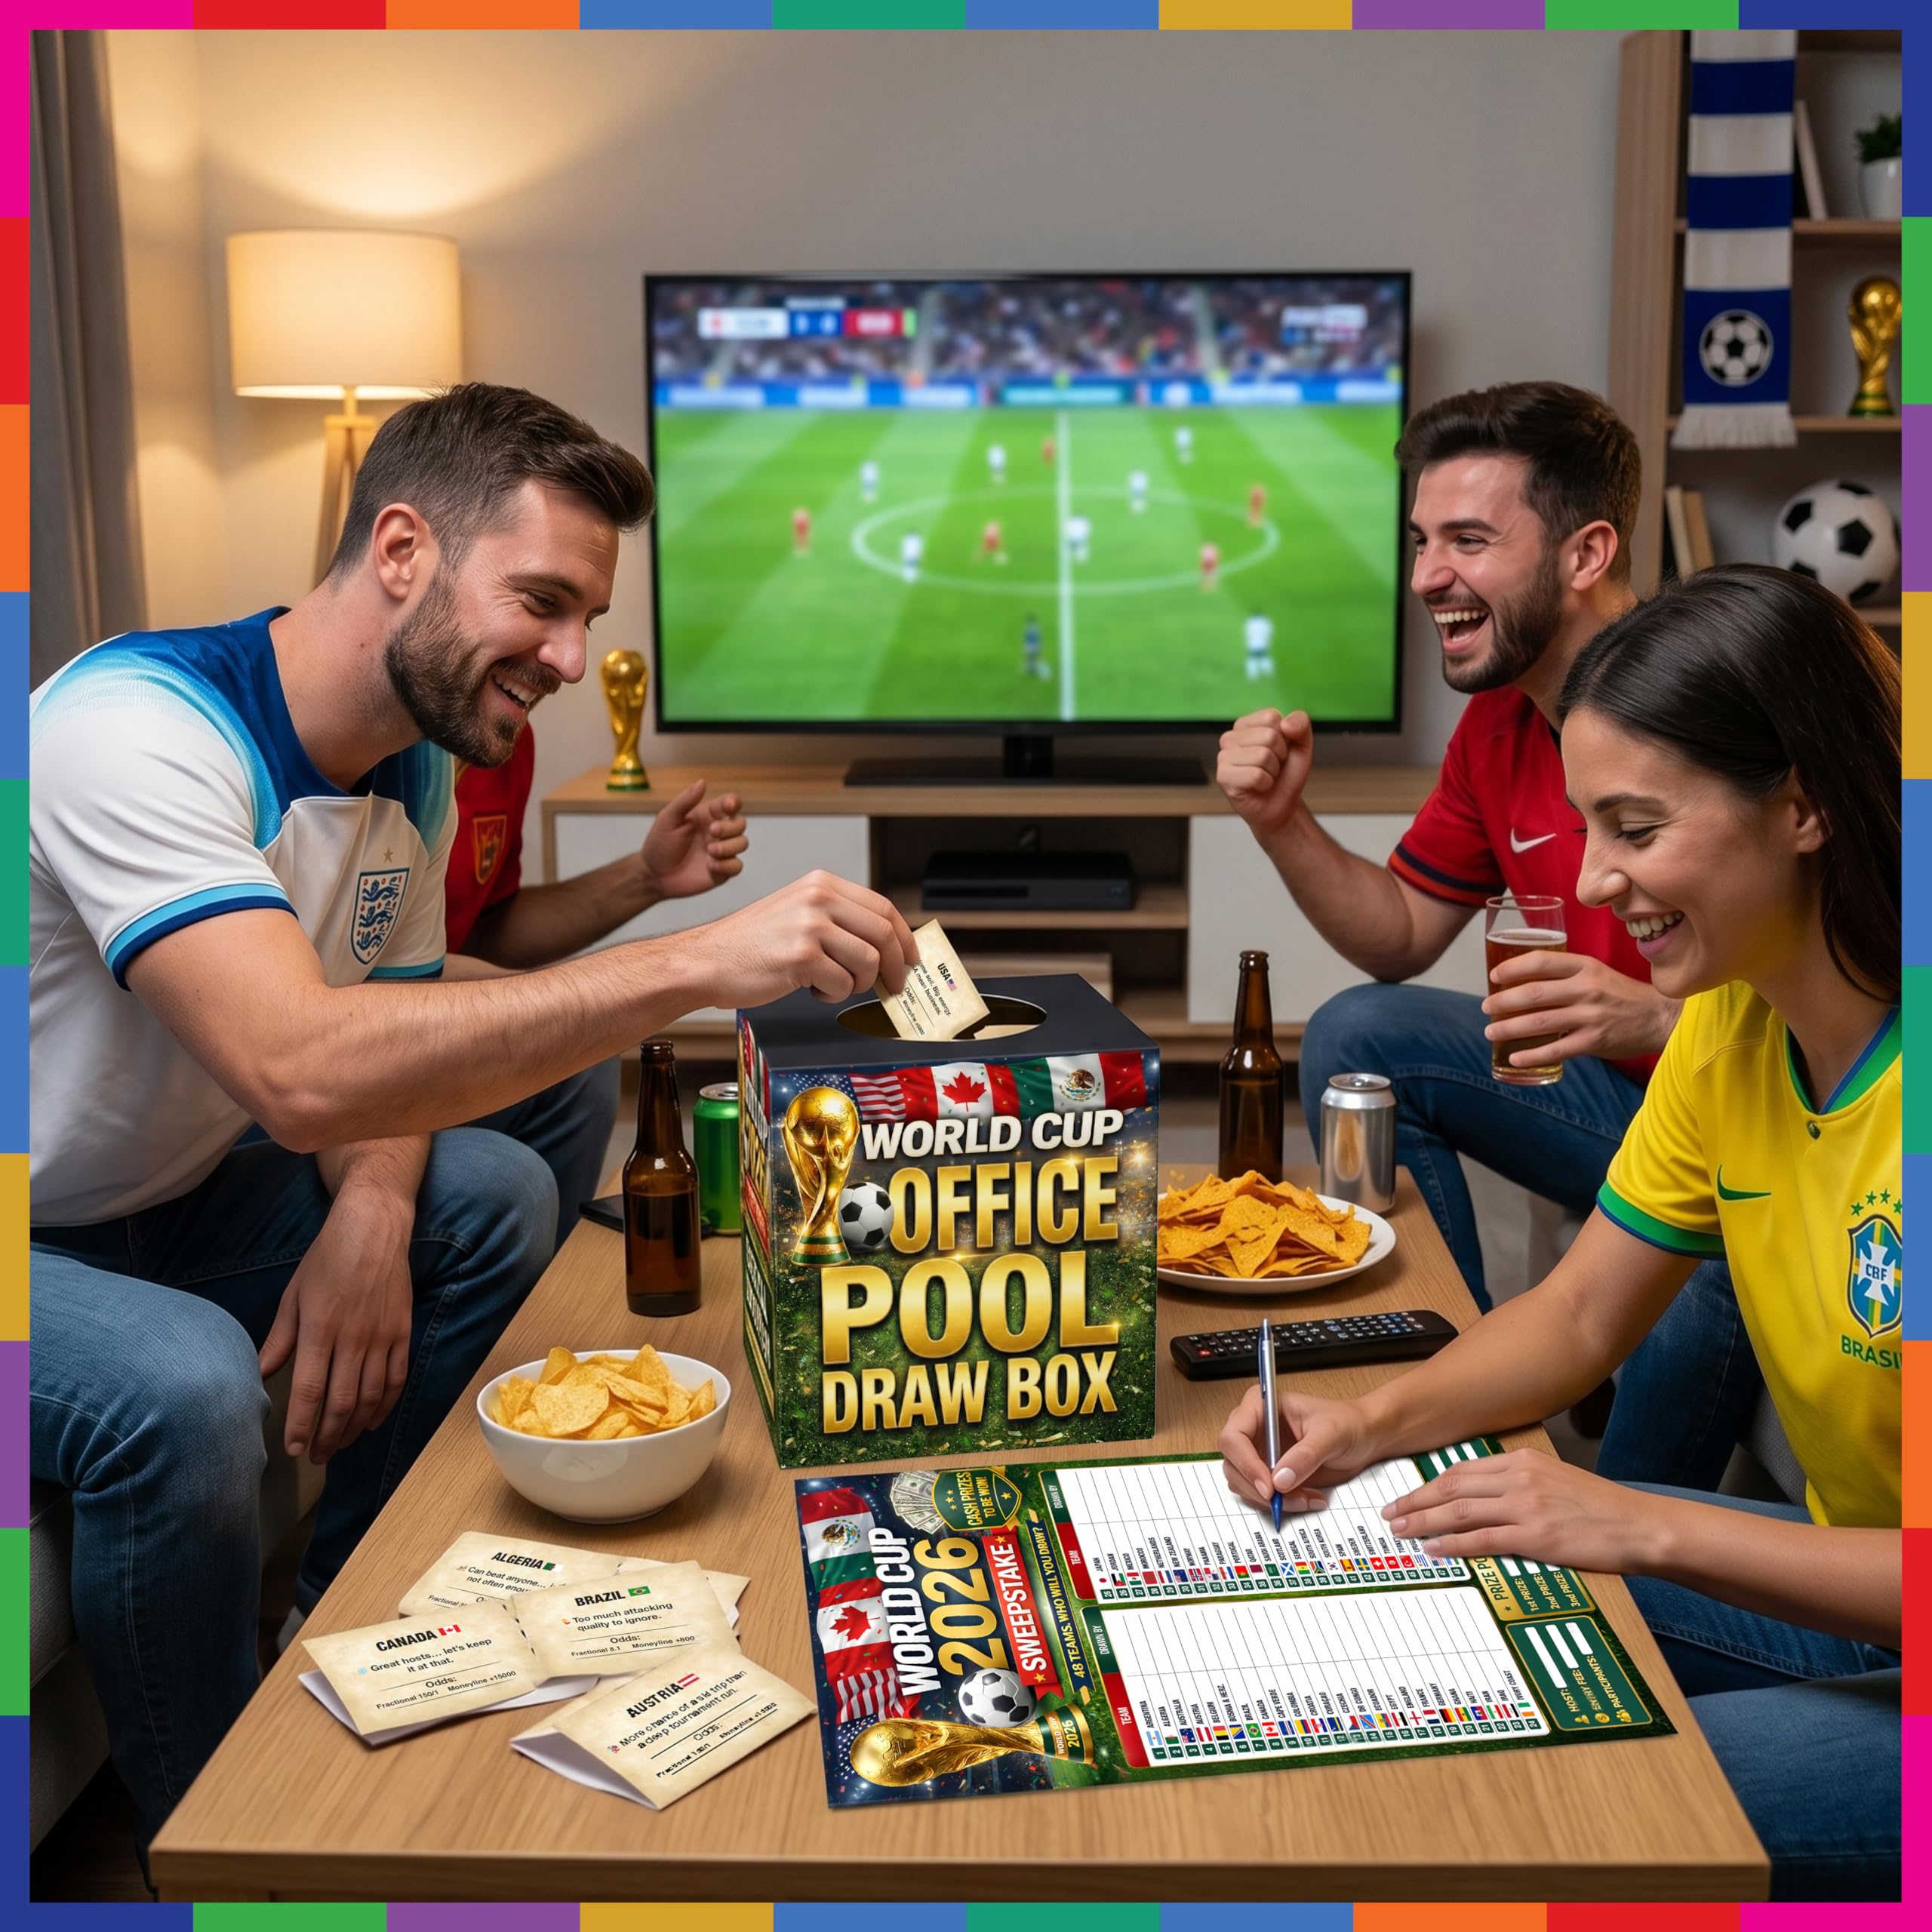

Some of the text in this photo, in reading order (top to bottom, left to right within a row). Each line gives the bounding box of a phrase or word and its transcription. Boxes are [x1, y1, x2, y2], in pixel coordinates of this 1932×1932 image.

[937, 963, 951, 980] USA
[905, 988, 916, 1004] Odds:
[916, 974, 940, 1015] mean business.
[926, 974, 935, 986] soil.
[939, 997, 951, 1017] energy.
[861, 1109, 1124, 1160] WORLD CUP
[888, 1156, 1118, 1254] OFFICE
[1865, 1263, 1887, 1281] CBF
[820, 1251, 1119, 1365] POOL
[1841, 1334, 1902, 1370] BRASI
[822, 1351, 1118, 1433] DRAW BOX
[957, 1472, 983, 1526] CASH PRIZES
[975, 1476, 996, 1518] TO BE WON!
[1051, 1493, 1063, 1509] DRAWN
[1254, 1532, 1271, 1561] SAUDI ARABIA
[1272, 1539, 1286, 1561] SCOTLAND
[1289, 1540, 1302, 1559] SENEGAL
[1299, 1528, 1316, 1558] SOUTH AFRICA
[1314, 1529, 1331, 1558] SOUTH KOREA
[1336, 1544, 1346, 1556] SPAIN
[1348, 1538, 1361, 1555] SWEDEN
[1358, 1526, 1376, 1555] SWITZERLAND
[1378, 1537, 1390, 1554] TUNISIA
[491, 1552, 543, 1569] ALGERIA
[1068, 1550, 1081, 1565] TEAM
[1107, 1554, 1118, 1571] JORDAN
[1123, 1553, 1134, 1570] MEXICO
[1137, 1548, 1149, 1568] MOROCCO
[1149, 1537, 1164, 1567] NETHERLANDS
[1164, 1537, 1180, 1567] NEW ZEALAND
[1183, 1549, 1195, 1566] NORWAY
[1198, 1547, 1211, 1565] PANAMA
[1212, 1542, 1226, 1564] PARAGUAY
[1227, 1541, 1241, 1563] PORTUGAL
[1245, 1549, 1256, 1562] QATAR
[468, 1567, 485, 1576] Can
[486, 1571, 506, 1580] beat
[1093, 1558, 1103, 1571] JAPAN
[481, 1580, 504, 1589] often
[1481, 1571, 1509, 1600] PRIZE
[1534, 1573, 1561, 1609] 2nd PRIZE:
[1553, 1571, 1572, 1595] PRIZE:
[428, 1595, 459, 1607] Fractional
[574, 1590, 626, 1606] BRAZIL
[1034, 1527, 1085, 1678] 48 TEAMS. WHO WILL YOU DRAW?
[1515, 1578, 1540, 1611] 1st PRIZE:
[593, 1611, 621, 1620] much
[623, 1602, 673, 1615] attacking
[868, 1527, 942, 1696] WORLD CUP
[913, 1537, 1009, 1675] 2026
[990, 1544, 1047, 1672] SWEEPSTAKE
[577, 1623, 609, 1632] quality
[625, 1614, 662, 1624] ignore.
[376, 1630, 438, 1652] CANADA
[571, 1647, 608, 1657] Fractional
[632, 1639, 673, 1649] Moneyline
[610, 1635, 640, 1644] Odds:
[1094, 1634, 1110, 1654] DRAWN
[371, 1660, 403, 1672] Great
[401, 1653, 441, 1665] hosts...
[466, 1638, 492, 1649] keep
[430, 1658, 454, 1668] that.
[426, 1676, 457, 1688] Odds:
[1504, 1671, 1524, 1700] IVORY COAST
[1572, 1669, 1587, 1685] FEE:
[1587, 1655, 1623, 1708] PARTICIPANTS:
[376, 1670, 516, 1709] Fractional 150/1 Moneyline +15000
[1217, 1684, 1228, 1698] HERZ.
[1350, 1688, 1363, 1704] CONGO
[1367, 1689, 1382, 1711] ECUADOR
[1399, 1687, 1414, 1708] ENGLAND
[1416, 1689, 1430, 1707] FRANCE
[1429, 1683, 1445, 1706] GERMANY
[1448, 1689, 1461, 1704] GHANA
[1466, 1691, 1477, 1703] HAITI
[1481, 1690, 1493, 1703] IRAN
[1497, 1690, 1509, 1701] IRAQ
[1560, 1688, 1580, 1712] HOST:
[620, 1730, 645, 1746] More
[645, 1710, 679, 1731] chance
[679, 1703, 690, 1712] of
[711, 1682, 728, 1694] trip
[728, 1670, 747, 1683] than
[626, 1683, 684, 1718] AUSTRIA
[1257, 1700, 1269, 1719] CANADA
[1269, 1689, 1285, 1718] CAPE VERDE
[1287, 1692, 1302, 1717] COLOMBIA
[1304, 1696, 1318, 1715] CROATIA
[1337, 1694, 1350, 1713] CZECHIA
[1386, 1694, 1398, 1709] EGYPT
[646, 1727, 669, 1744] deep
[671, 1697, 721, 1730] tournament
[721, 1687, 739, 1700] run.
[1117, 1707, 1133, 1725] TEAM
[1140, 1701, 1155, 1728] ARGENTINA
[1158, 1706, 1171, 1727] ALGERIA
[1173, 1700, 1188, 1725] AUSTRALIA
[1191, 1704, 1204, 1724] AUSTRIA
[1207, 1702, 1220, 1723] BELGIUM
[1225, 1704, 1236, 1721] BOSNIA
[1241, 1704, 1253, 1720] BRAZIL
[1048, 1716, 1065, 1755] WORLD CUP
[1062, 1719, 1081, 1748] 2026
